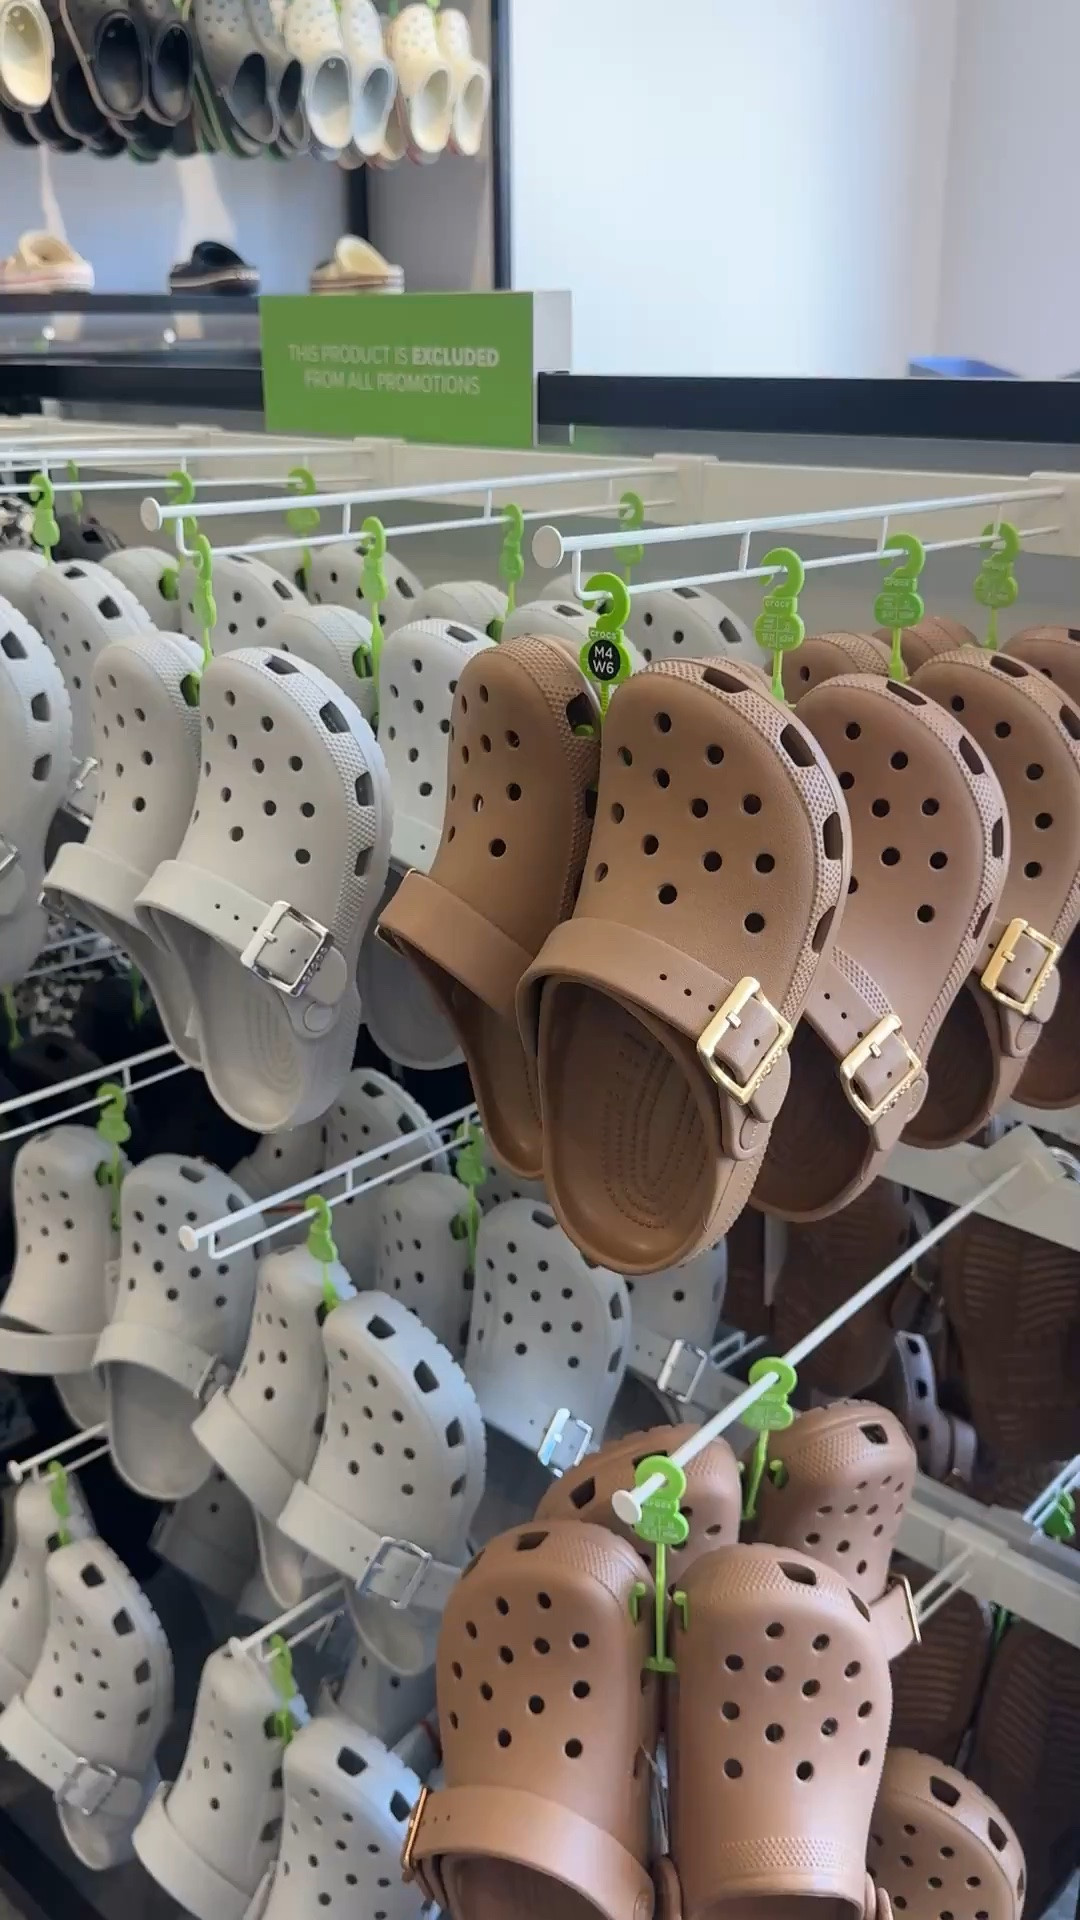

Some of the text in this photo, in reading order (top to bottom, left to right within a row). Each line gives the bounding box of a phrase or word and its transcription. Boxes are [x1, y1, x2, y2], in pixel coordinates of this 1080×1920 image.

[288, 344, 499, 367] THIS PRODUCT IS EXCLUDED
[304, 370, 480, 395] FROM ALL PROMOTIONS
[590, 630, 617, 640] crocs
[594, 645, 613, 660] M4
[592, 659, 614, 675] W6
